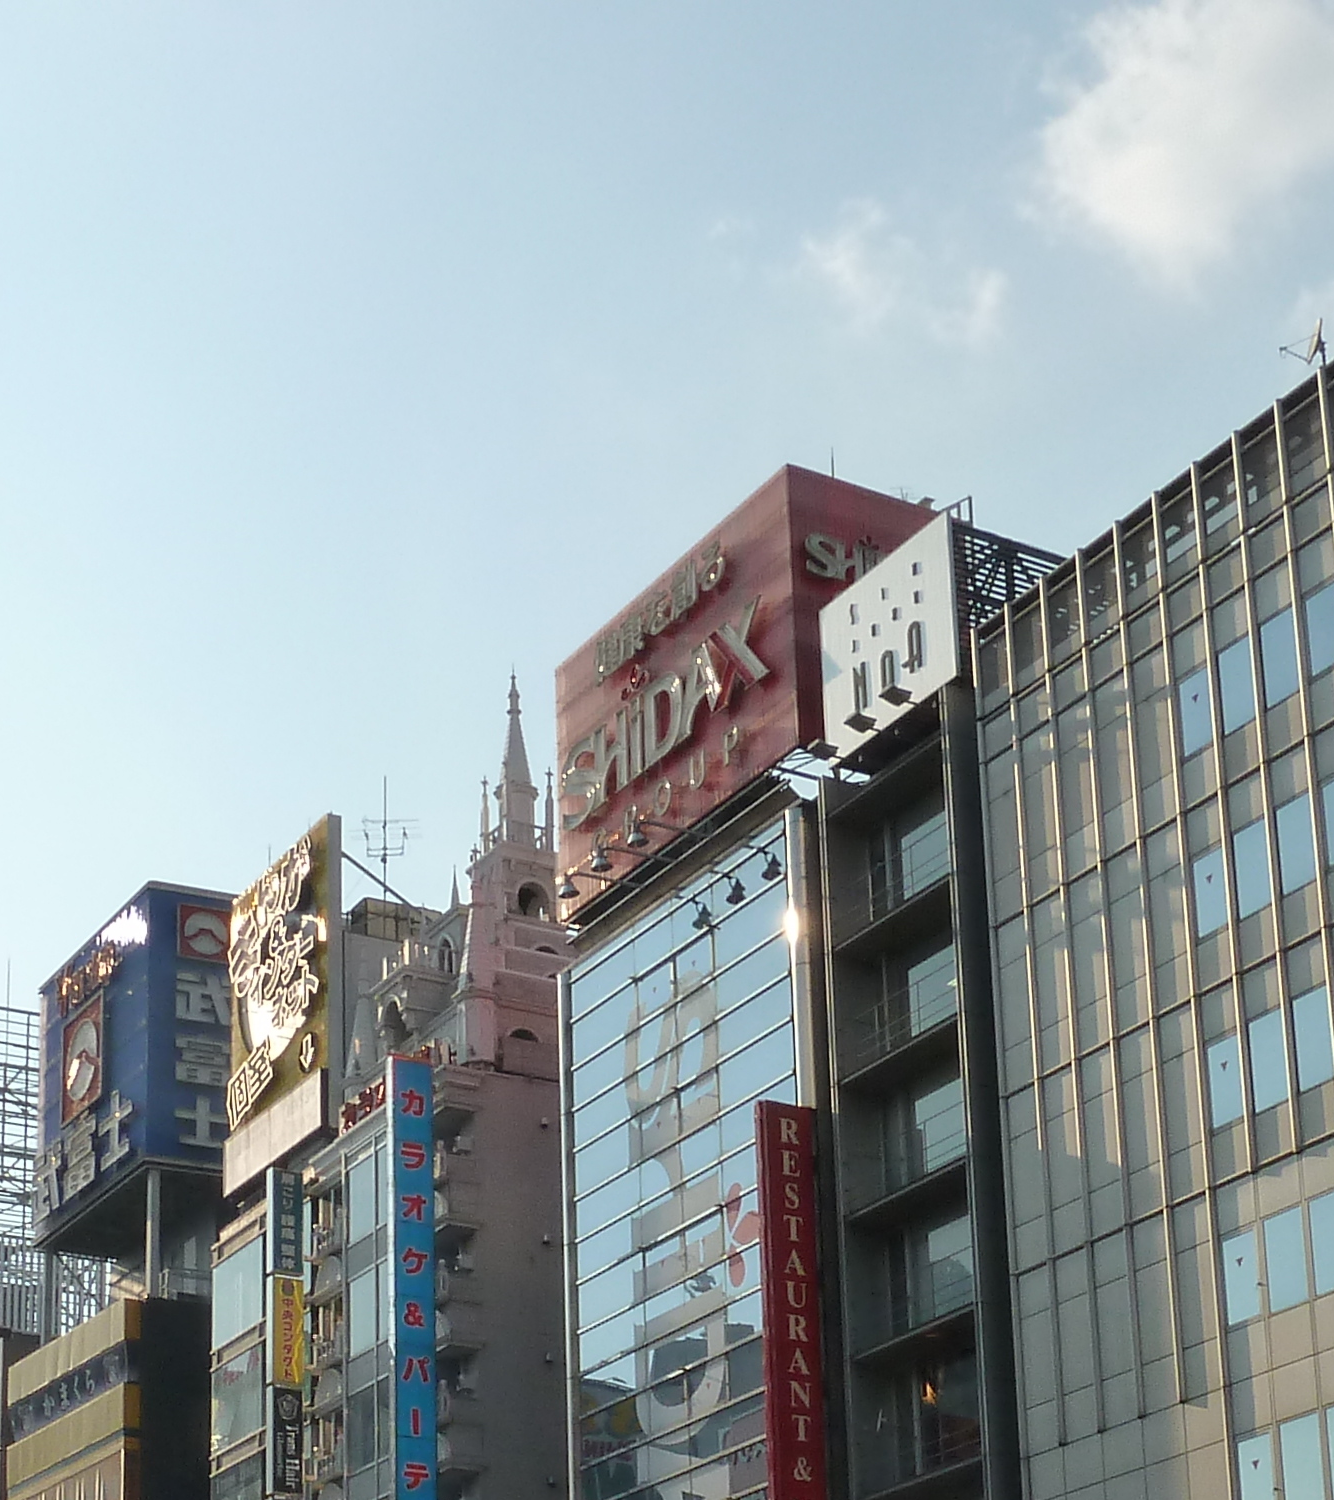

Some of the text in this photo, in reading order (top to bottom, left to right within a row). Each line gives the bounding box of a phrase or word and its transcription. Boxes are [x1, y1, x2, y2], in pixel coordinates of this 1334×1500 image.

[174, 971, 233, 1149] 武富士
[31, 1087, 134, 1226] 武富士
[777, 1116, 813, 1445] RESTAURANT
[791, 1454, 815, 1484] &
